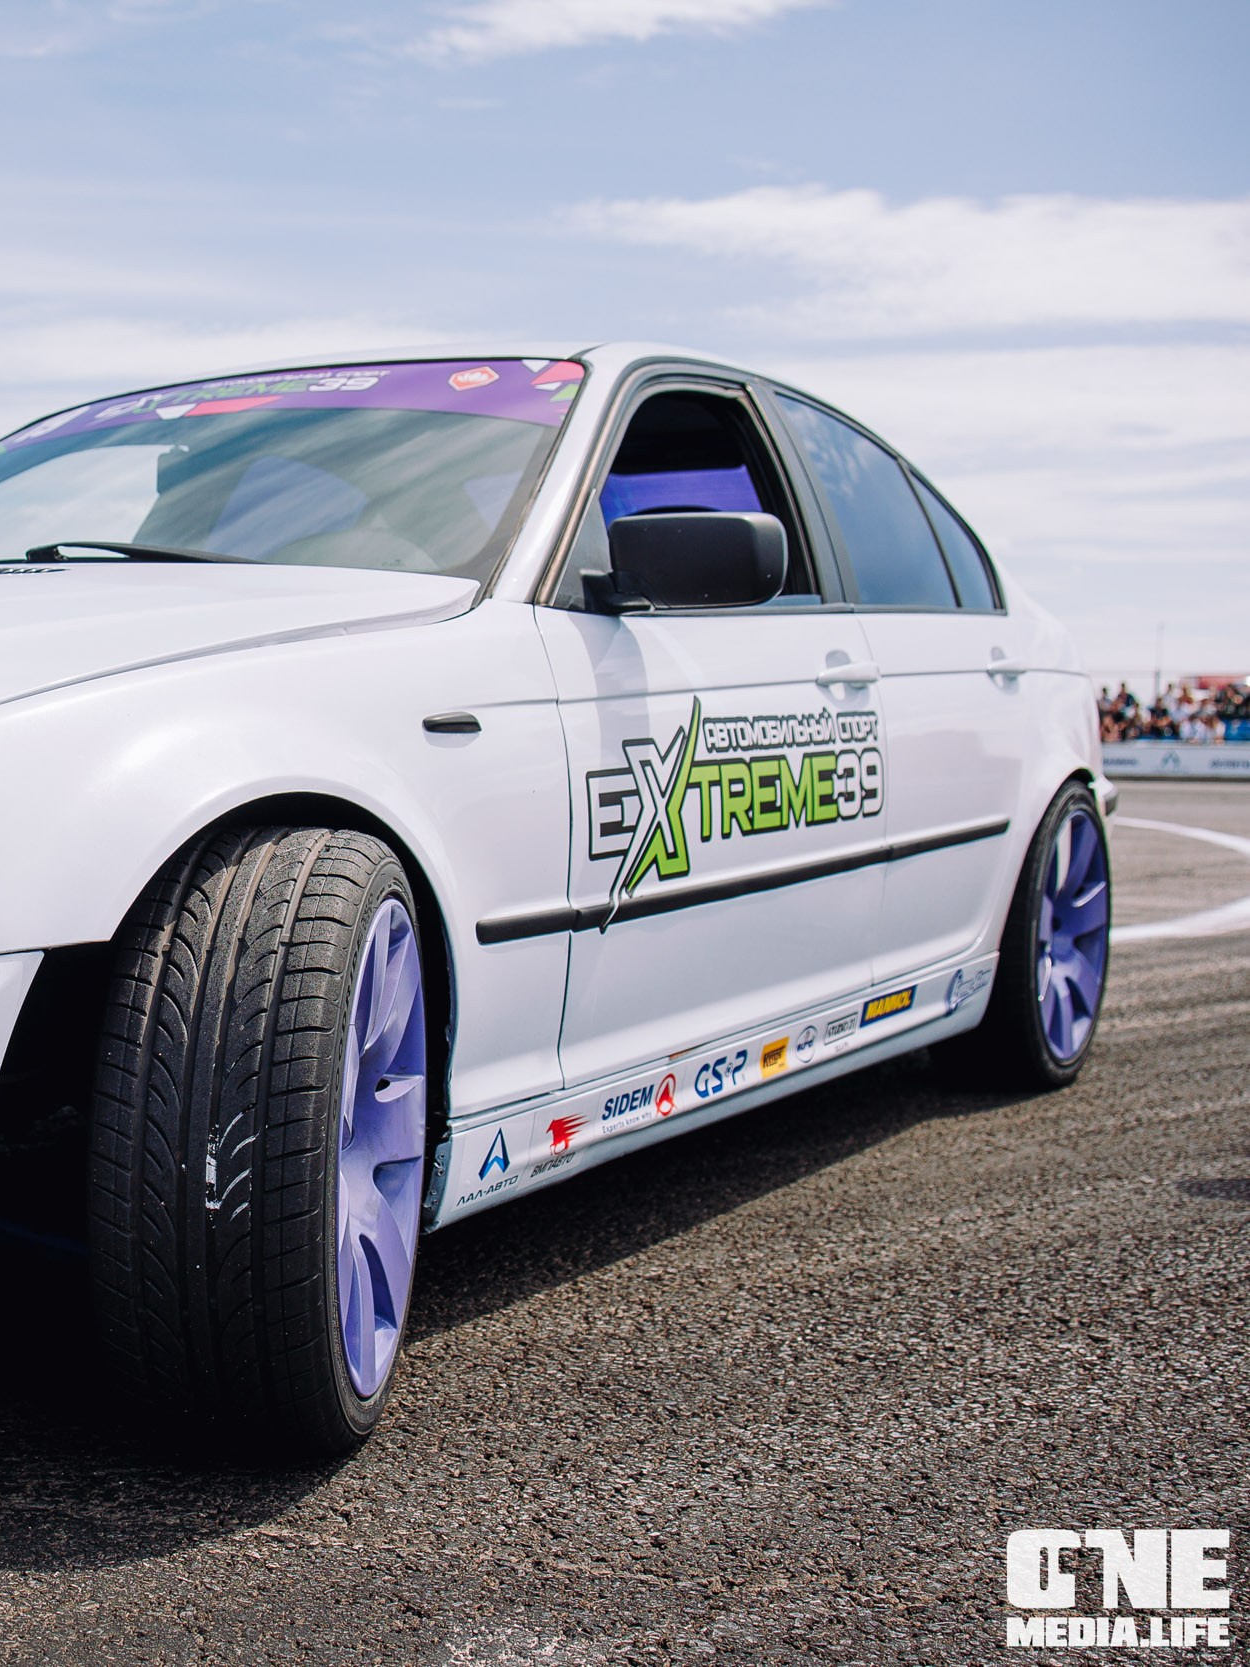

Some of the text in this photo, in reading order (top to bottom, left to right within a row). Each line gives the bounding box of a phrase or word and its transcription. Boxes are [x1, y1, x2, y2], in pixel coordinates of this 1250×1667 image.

[703, 708, 880, 753] АВТОМОБИЛЬНЫЙ СПОРТ
[864, 989, 912, 1021] MANNOL
[601, 1084, 655, 1121] SIDEM
[602, 1122, 625, 1135] Experts
